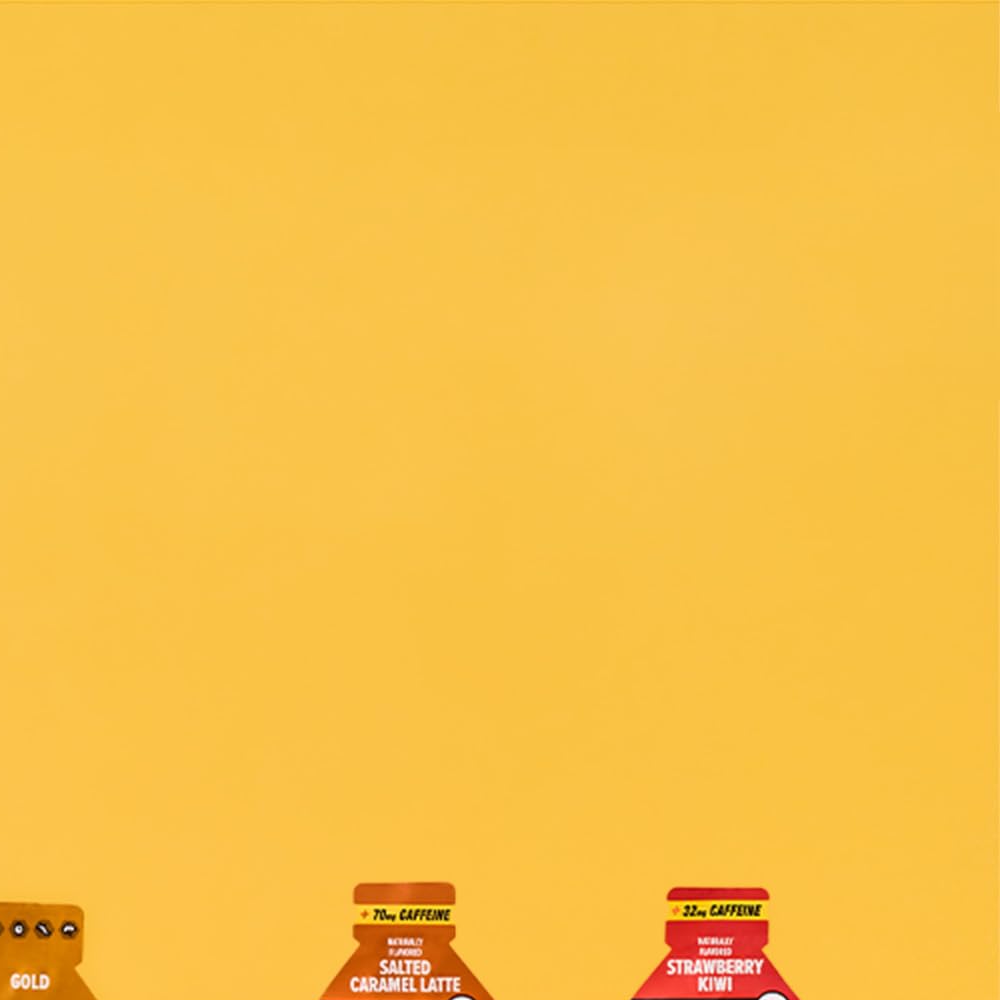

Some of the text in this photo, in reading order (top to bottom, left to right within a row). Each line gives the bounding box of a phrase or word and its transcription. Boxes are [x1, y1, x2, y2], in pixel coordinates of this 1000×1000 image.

[399, 908, 451, 921] CAFFEINE
[709, 904, 762, 917] CAFFEINE
[379, 960, 431, 975] SALTED
[667, 959, 764, 975] STRAWBERRY
[10, 973, 50, 990] GOLD
[350, 977, 461, 993] CARAMEL LATTE
[698, 976, 733, 992] KIWI
